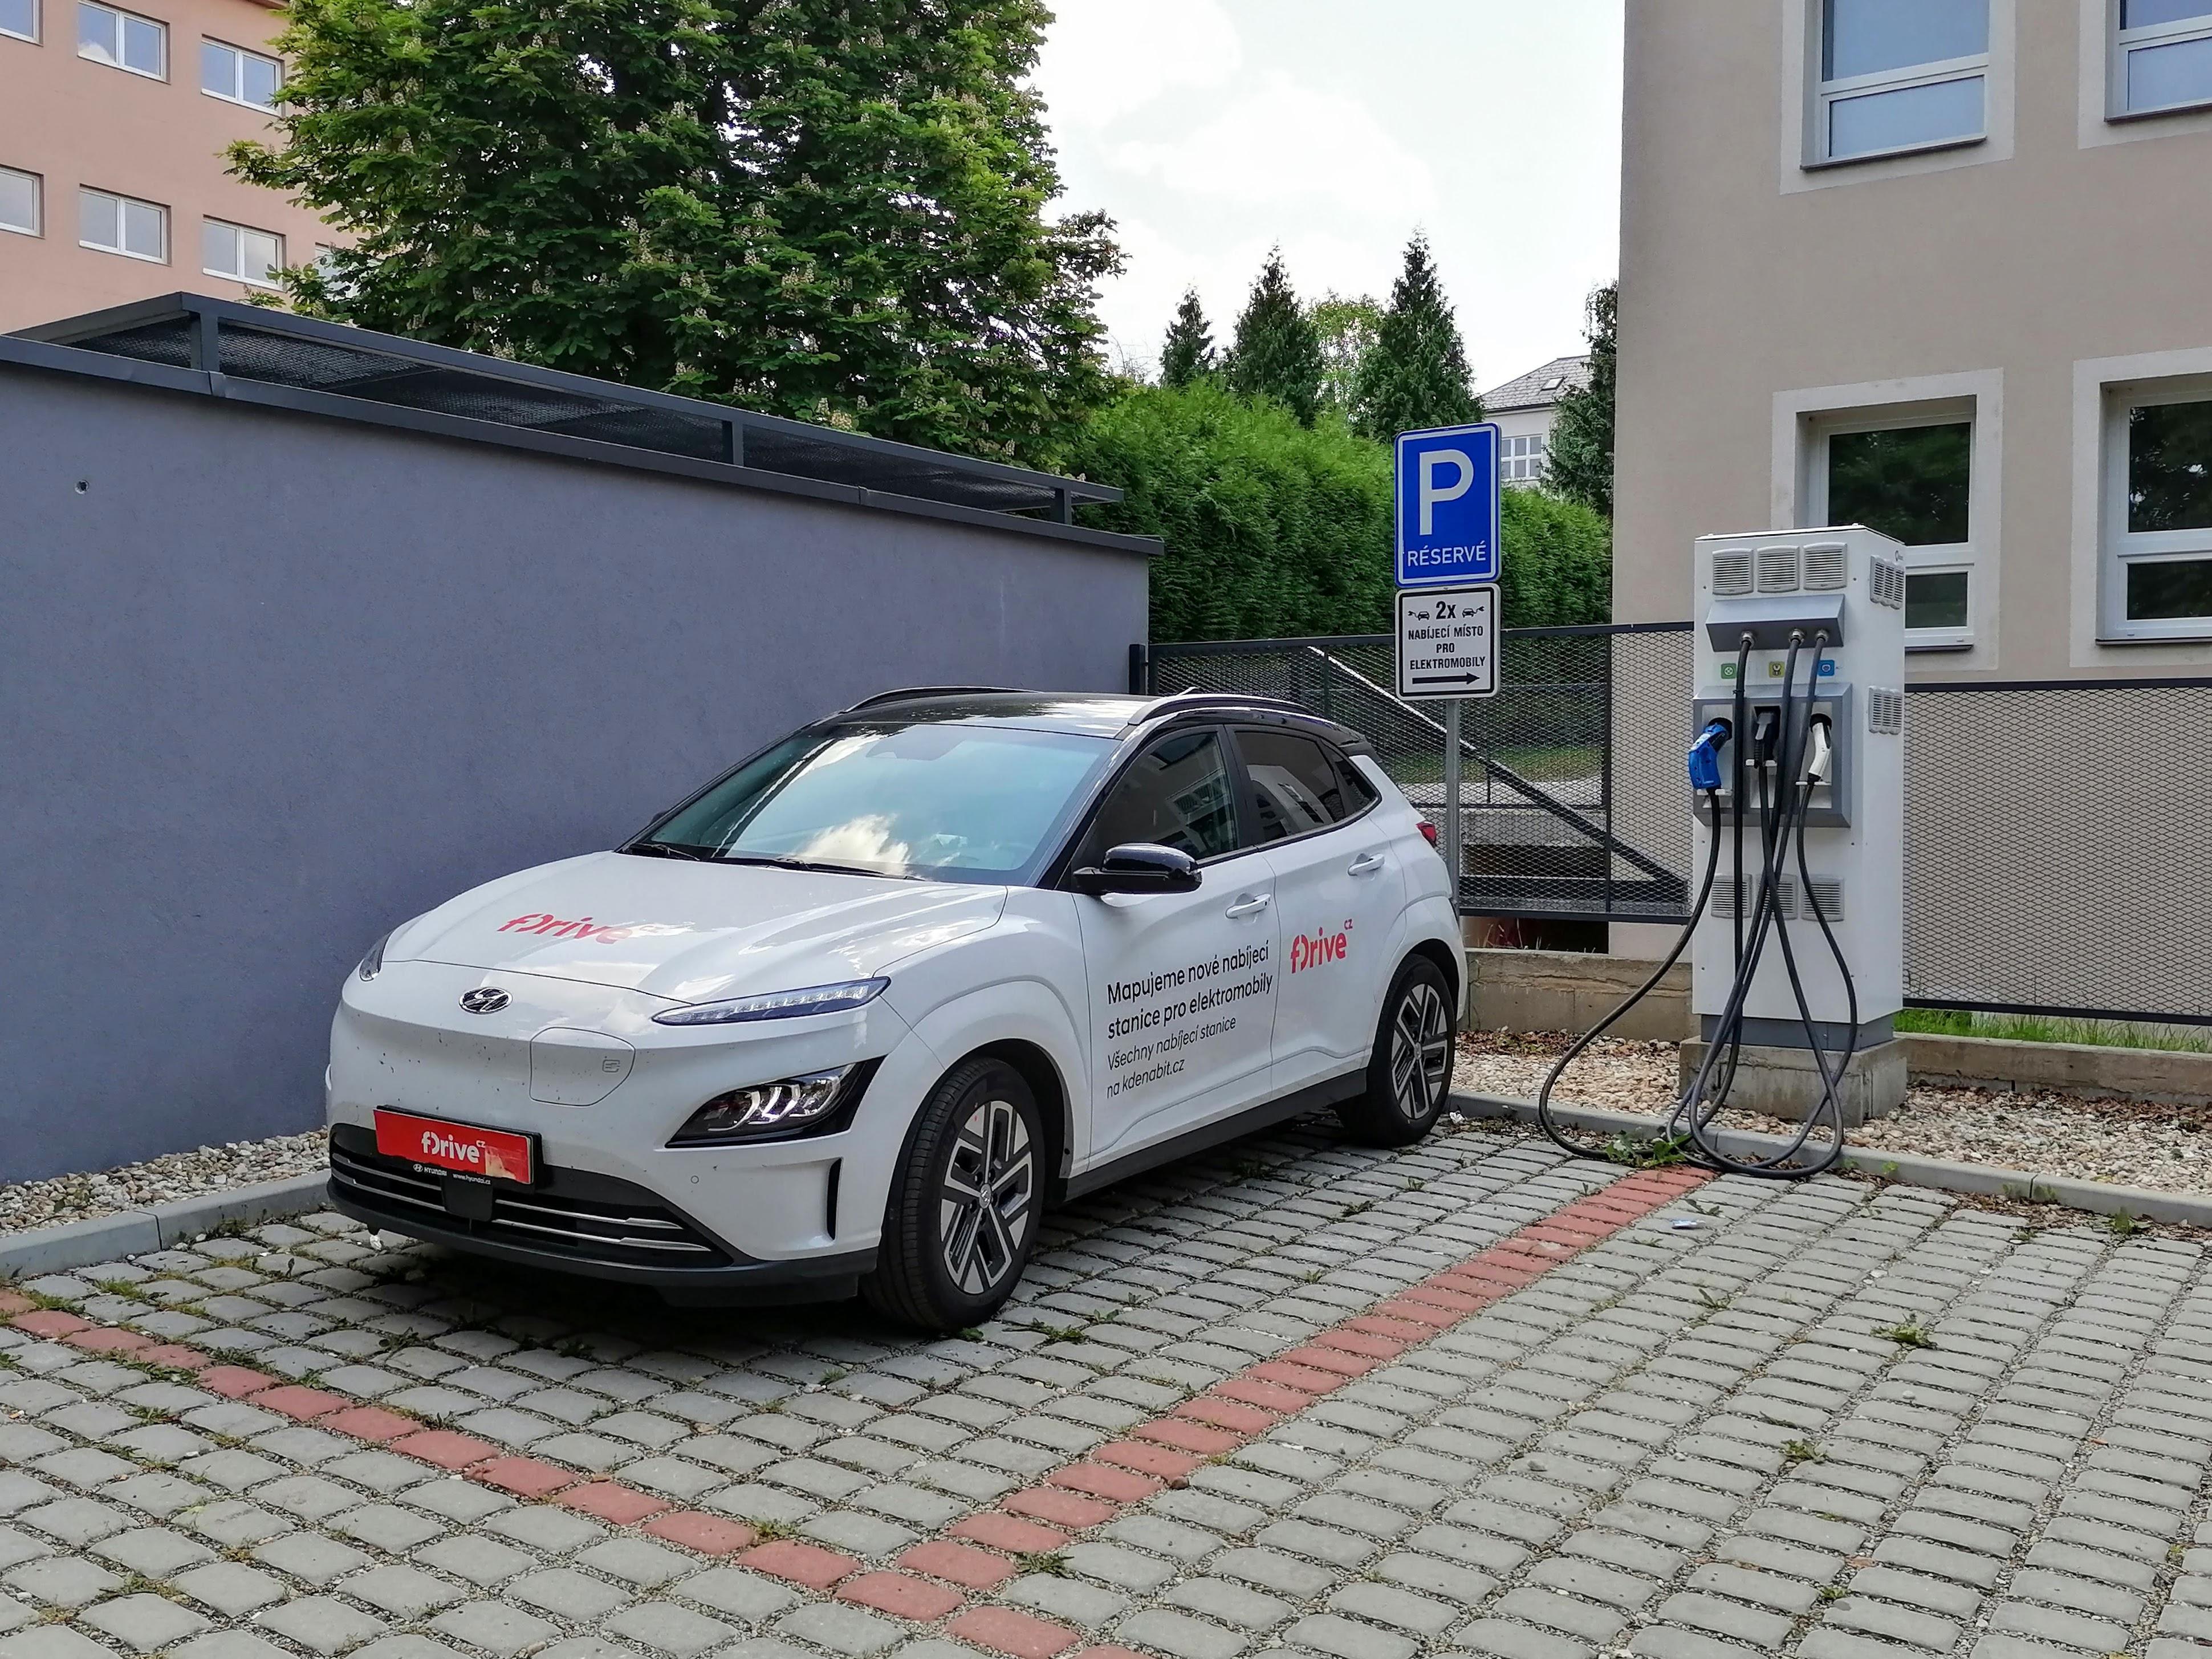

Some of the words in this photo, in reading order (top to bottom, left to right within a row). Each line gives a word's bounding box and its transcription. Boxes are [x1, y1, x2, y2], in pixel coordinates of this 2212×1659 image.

[1419, 449, 1474, 535] P
[1408, 540, 1487, 567] RÉSERVÉ
[1436, 600, 1457, 620] 2x
[1408, 626, 1450, 640] NABÍJECÍ
[1454, 623, 1483, 638] MÍSTO
[1436, 643, 1455, 654] PRO
[1410, 656, 1486, 670] ELEKTROMOBILY
[1107, 970, 1185, 1005] Mapujeme
[1188, 954, 1219, 983] nové
[1222, 940, 1270, 973] nabíjecí
[1108, 1008, 1160, 1039] stanice
[1164, 1001, 1186, 1027] pro
[1189, 973, 1273, 1014] elektromobily
[1108, 1042, 1154, 1071] Všechny
[1156, 1025, 1199, 1055] nabíjecí
[1199, 1016, 1237, 1040] stanice
[1107, 1083, 1120, 1099] na
[1122, 1058, 1185, 1091] kdenabit.cz
[424, 1166, 447, 1176] HYUNDAI
